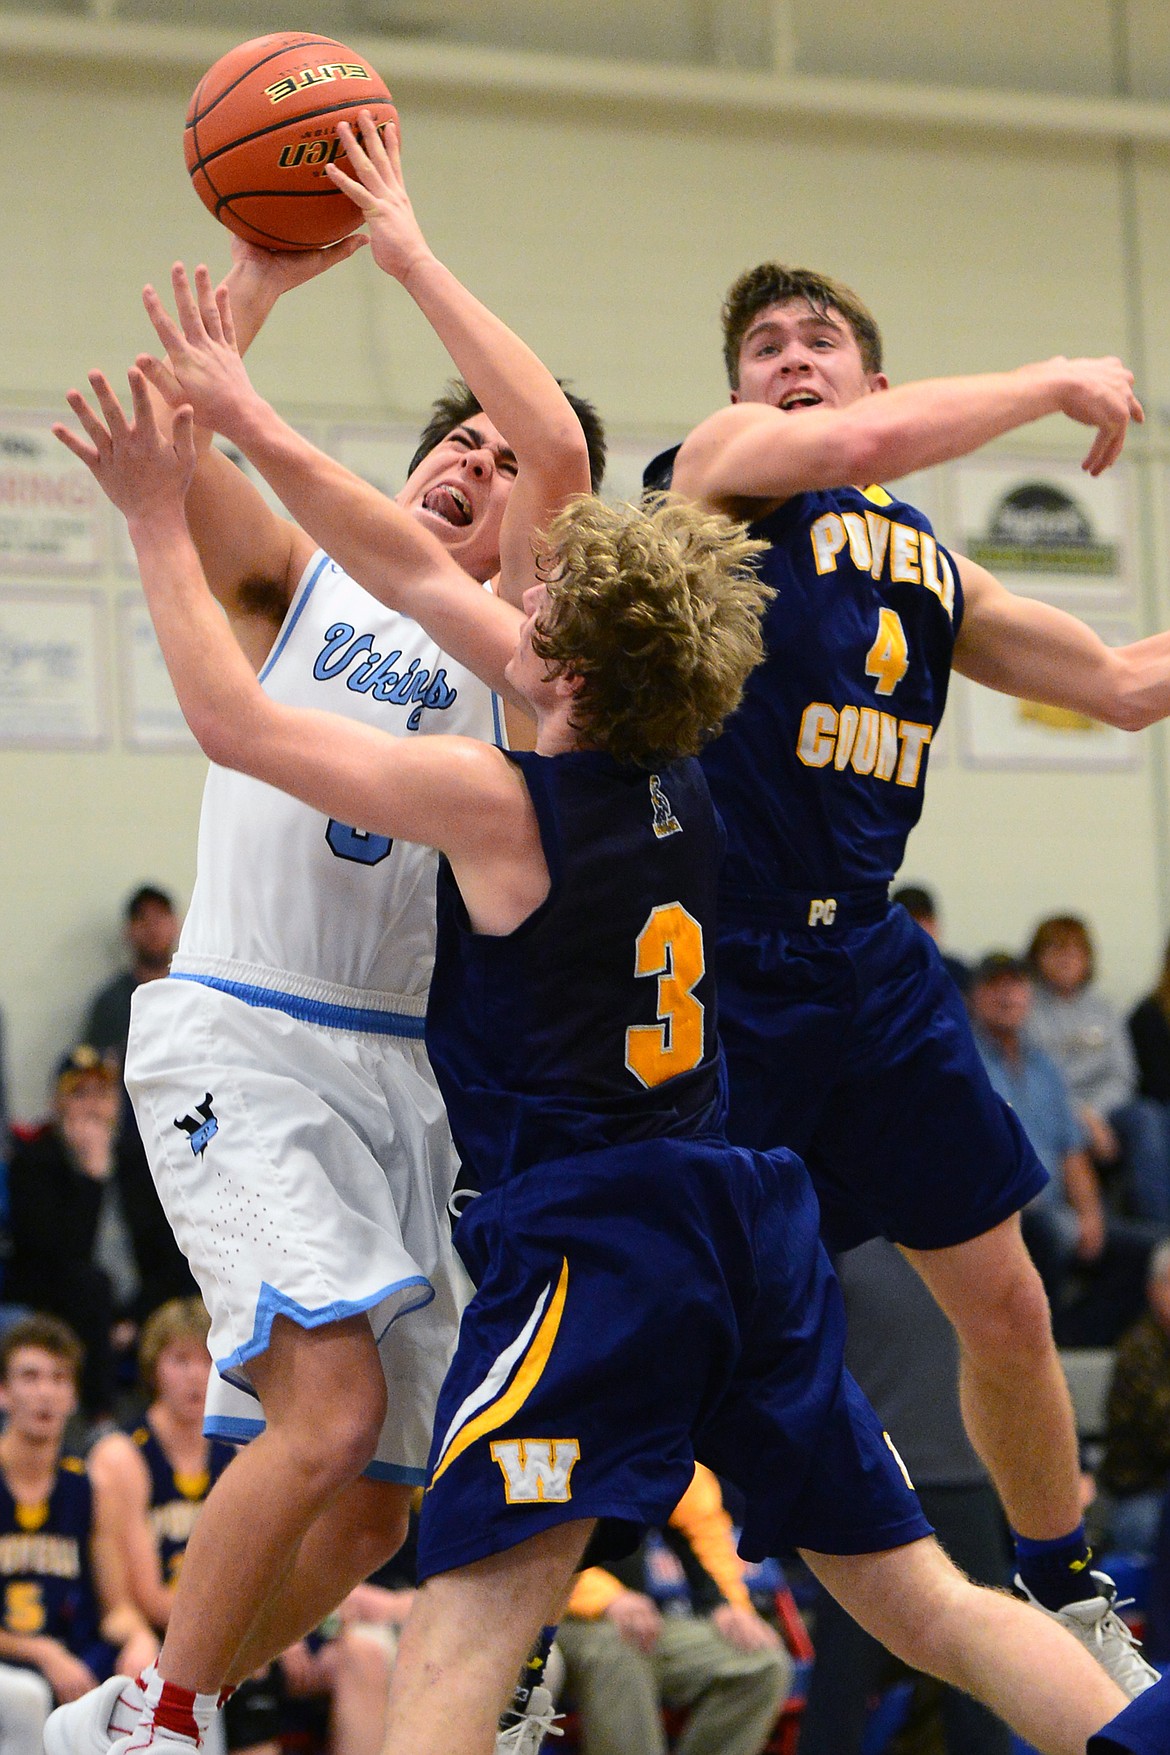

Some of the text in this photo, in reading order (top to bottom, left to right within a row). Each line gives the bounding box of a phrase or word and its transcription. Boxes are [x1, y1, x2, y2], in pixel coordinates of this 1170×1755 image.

[264, 62, 372, 104] ELITE
[313, 622, 457, 731] Vikings
[865, 606, 910, 696] 4
[808, 898, 837, 926] PC
[625, 901, 705, 1089] 3
[490, 1438, 580, 1504] W
[5, 1580, 45, 1633] 5
